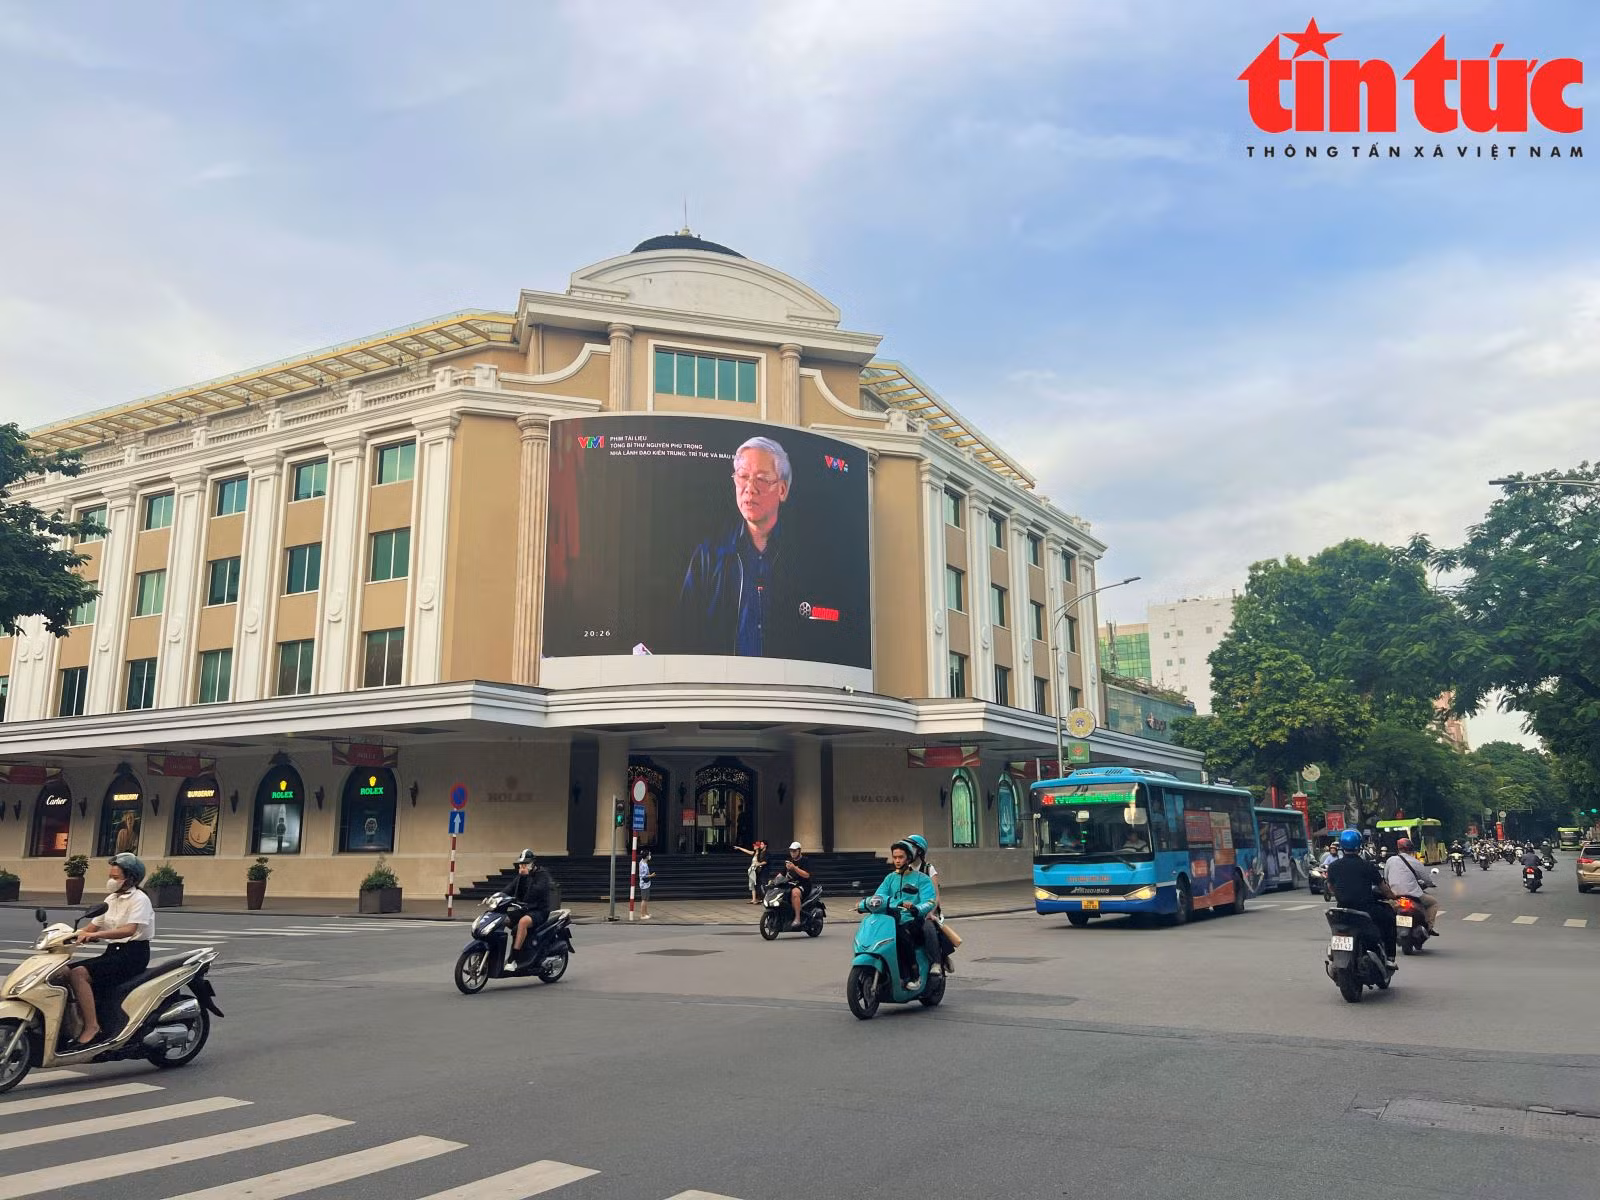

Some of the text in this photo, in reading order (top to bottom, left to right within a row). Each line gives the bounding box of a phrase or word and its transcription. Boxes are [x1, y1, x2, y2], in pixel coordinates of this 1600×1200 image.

[271, 791, 294, 799] ROLEX
[360, 787, 384, 796] ROLEX
[46, 794, 68, 806] Cartier
